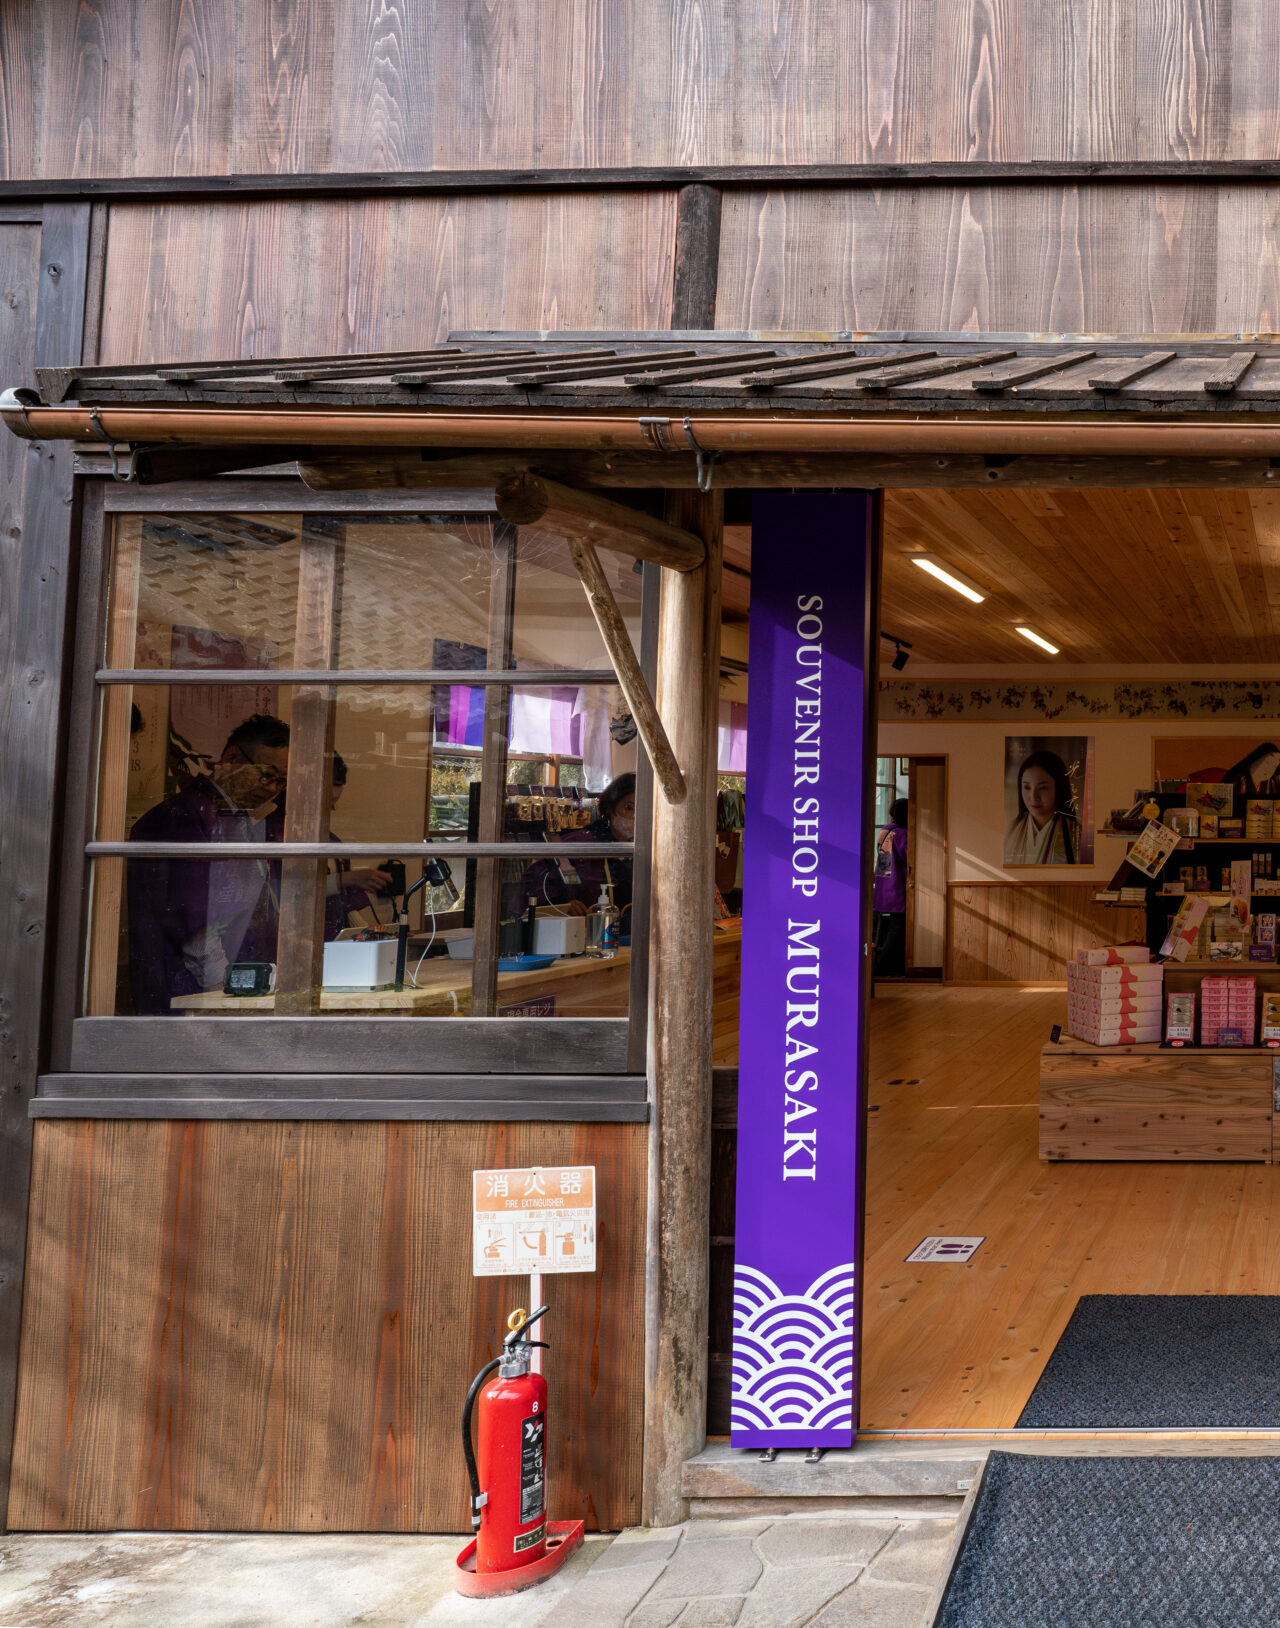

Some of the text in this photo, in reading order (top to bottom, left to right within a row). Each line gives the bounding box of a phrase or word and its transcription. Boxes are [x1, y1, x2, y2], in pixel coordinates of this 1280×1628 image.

[783, 595, 824, 1181] SOUVENIR SHOP MURASAKI
[486, 1172, 582, 1197] 消火器
[505, 1198, 564, 1208] FIRE EXTINGUISHER
[531, 1400, 539, 1413] 8
